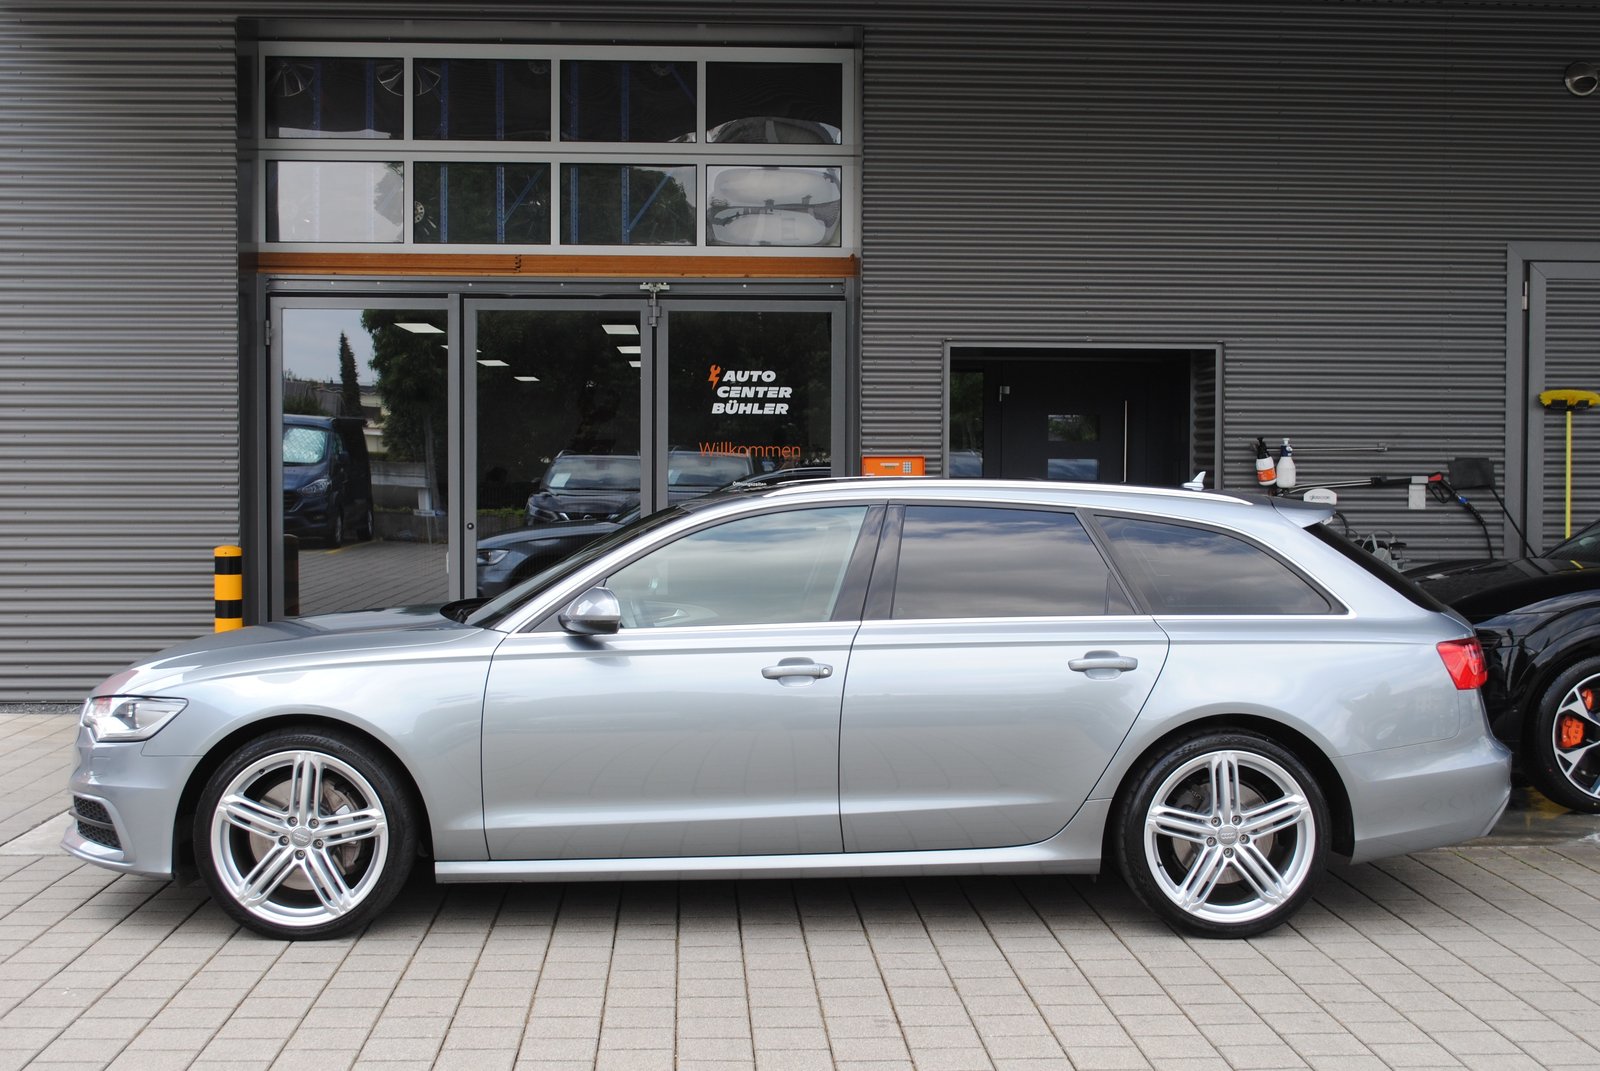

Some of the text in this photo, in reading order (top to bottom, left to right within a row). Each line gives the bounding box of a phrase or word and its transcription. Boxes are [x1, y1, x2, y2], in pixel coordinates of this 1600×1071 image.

[722, 370, 777, 383] AUTO
[716, 386, 793, 398] CENTER
[711, 400, 789, 414] BÜHLER
[699, 442, 801, 457] Willkommen
